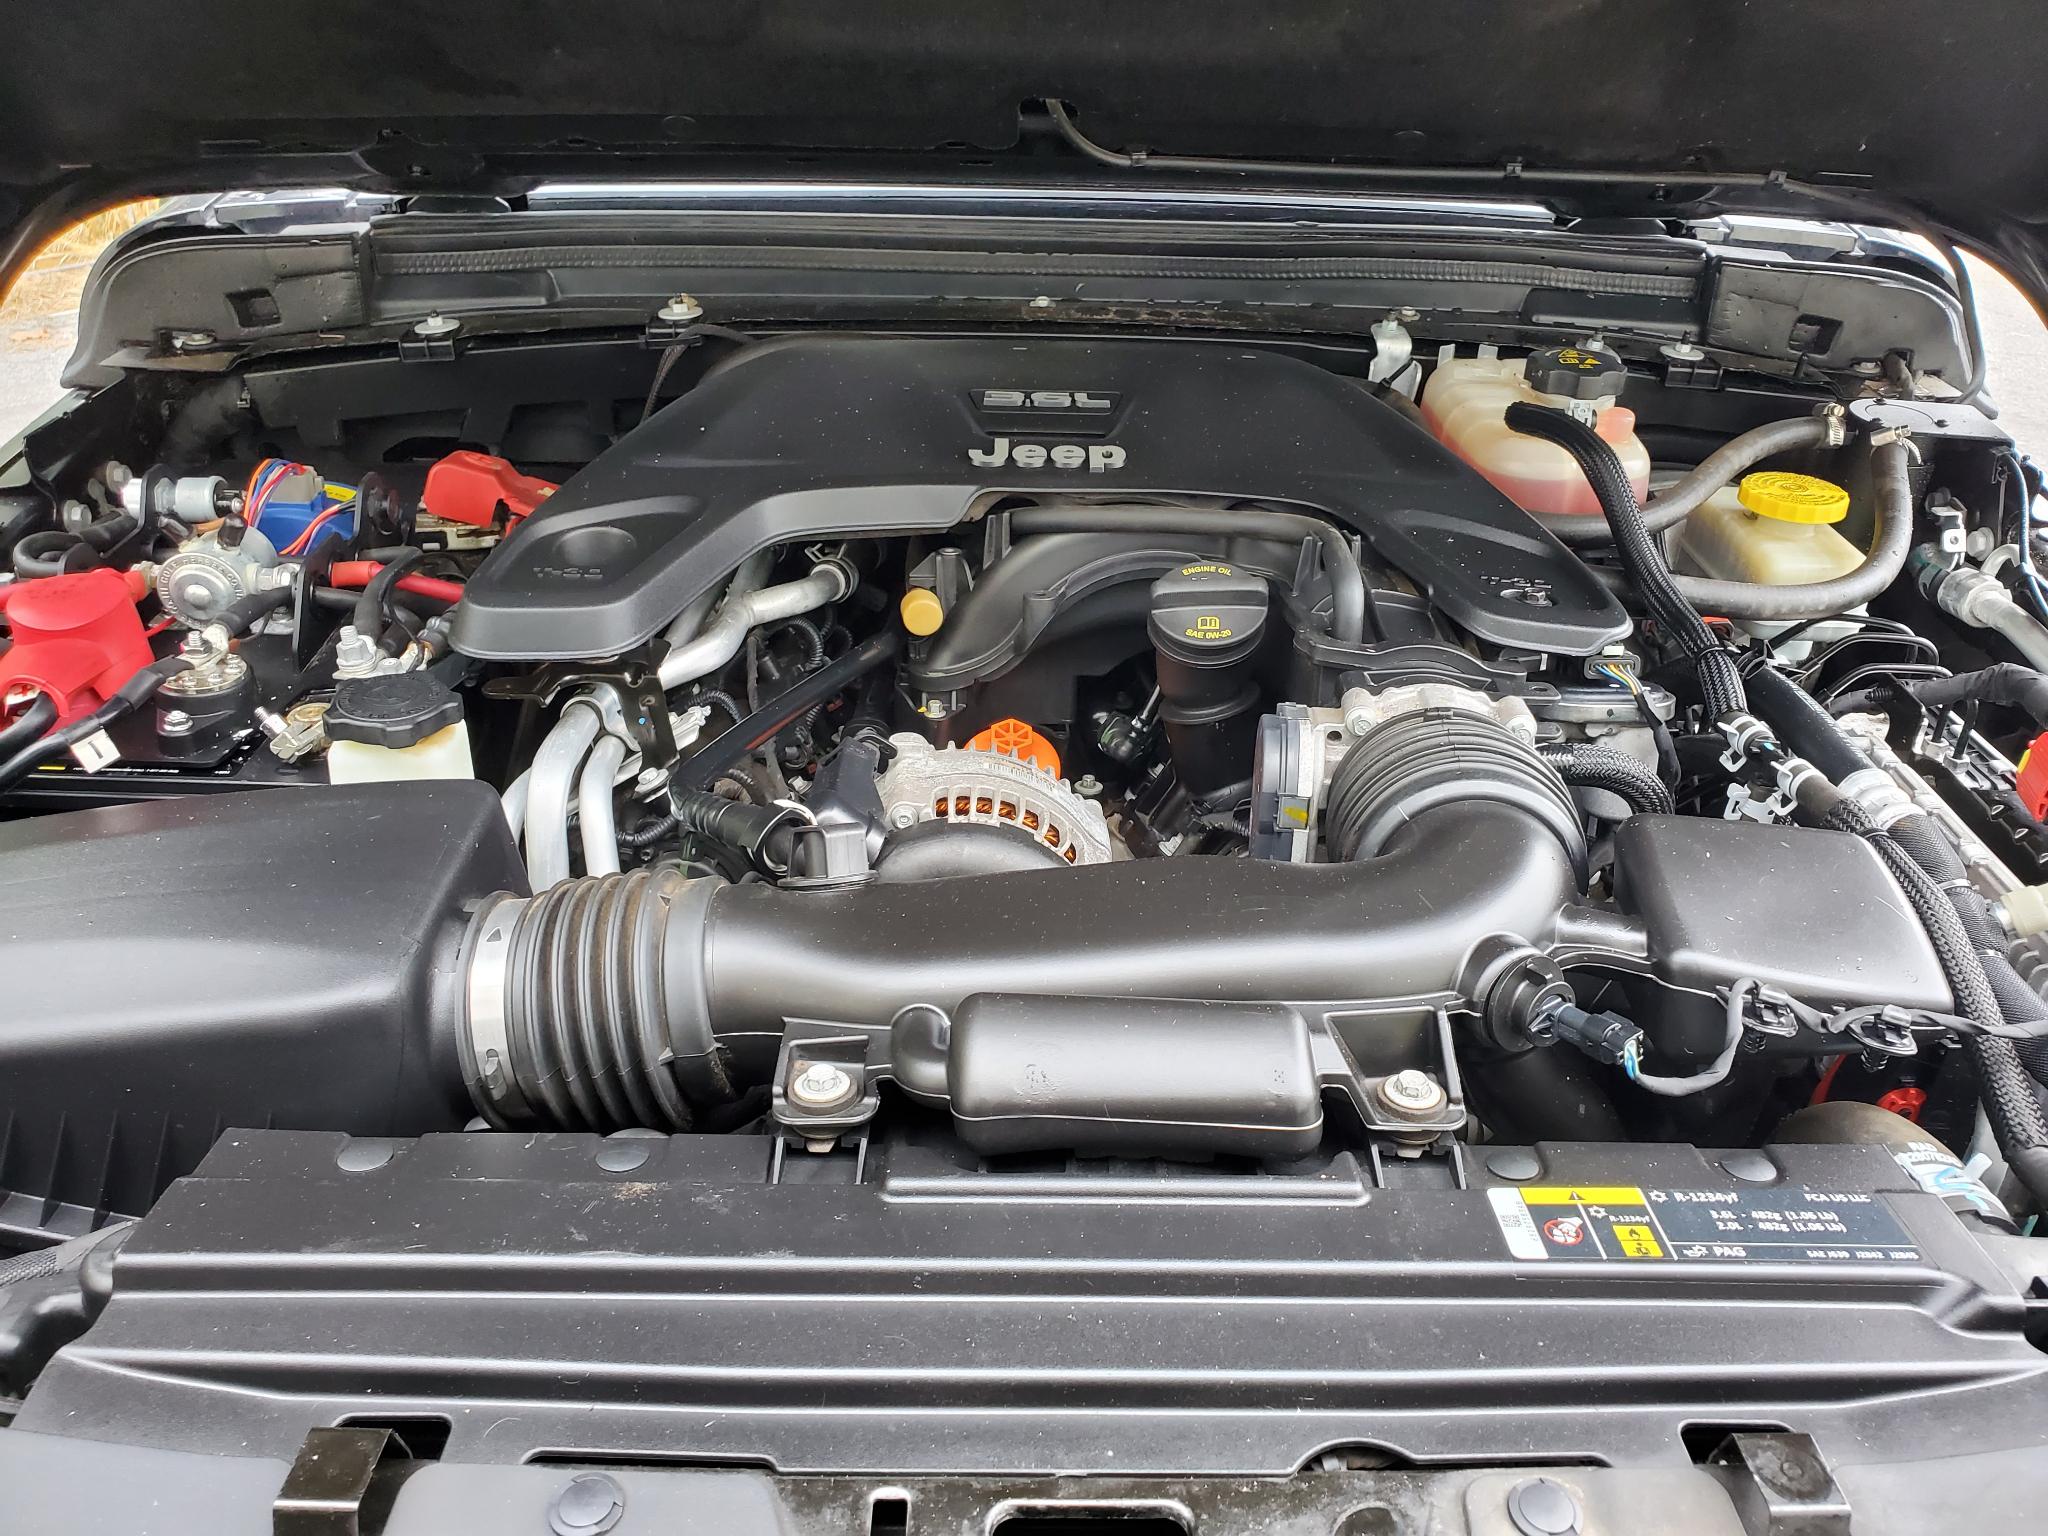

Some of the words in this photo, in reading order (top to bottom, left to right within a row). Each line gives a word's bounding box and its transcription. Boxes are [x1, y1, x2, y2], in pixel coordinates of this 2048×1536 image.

[983, 391, 1111, 408] 3.6L
[968, 437, 1127, 473] Jeep
[1181, 565, 1217, 576] ENGINE
[1218, 567, 1232, 576] OIL
[1185, 628, 1205, 639] SAE
[1206, 629, 1232, 639] 0W-20
[1674, 1192, 1739, 1204] R-1234yf
[1803, 1193, 1830, 1202] FCA
[1830, 1193, 1849, 1202] US
[1848, 1194, 1872, 1203] LLC
[1712, 1246, 1746, 1257] PAG
